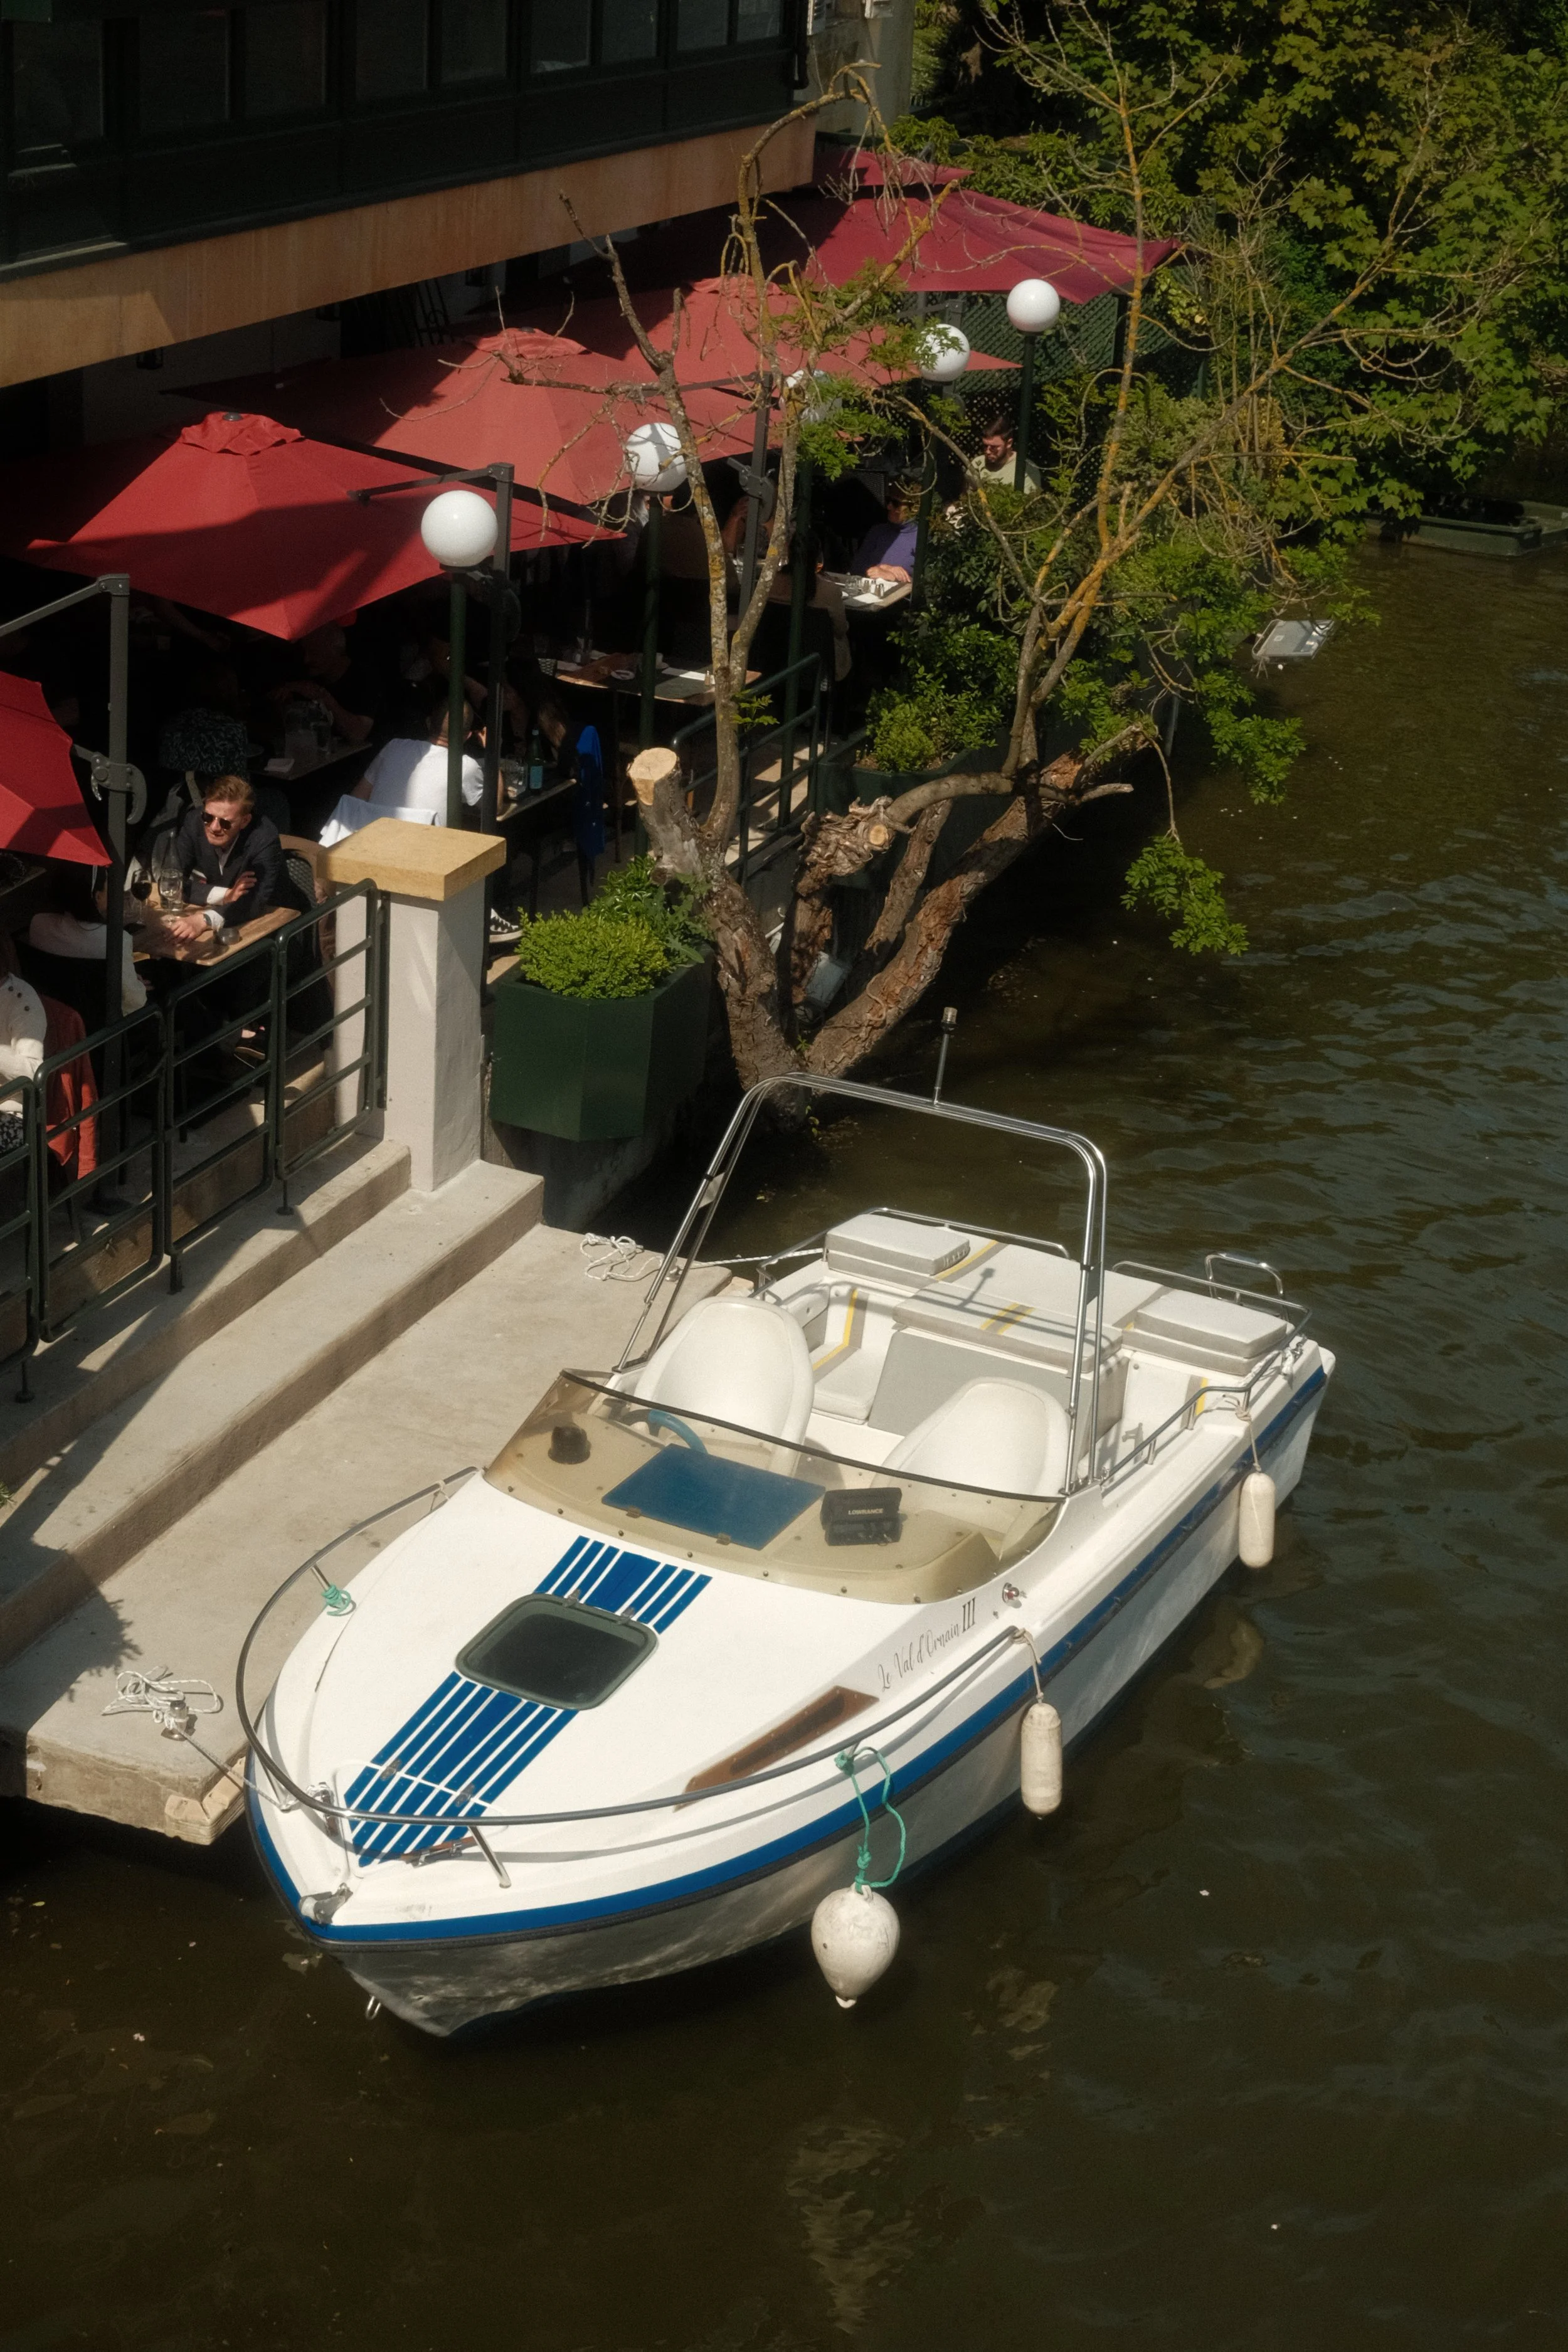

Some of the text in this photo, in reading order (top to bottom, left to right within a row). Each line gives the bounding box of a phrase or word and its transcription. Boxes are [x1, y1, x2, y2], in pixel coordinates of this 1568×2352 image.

[878, 1663, 892, 1692] Le
[894, 1641, 914, 1678] Val
[962, 1596, 976, 1633] III
